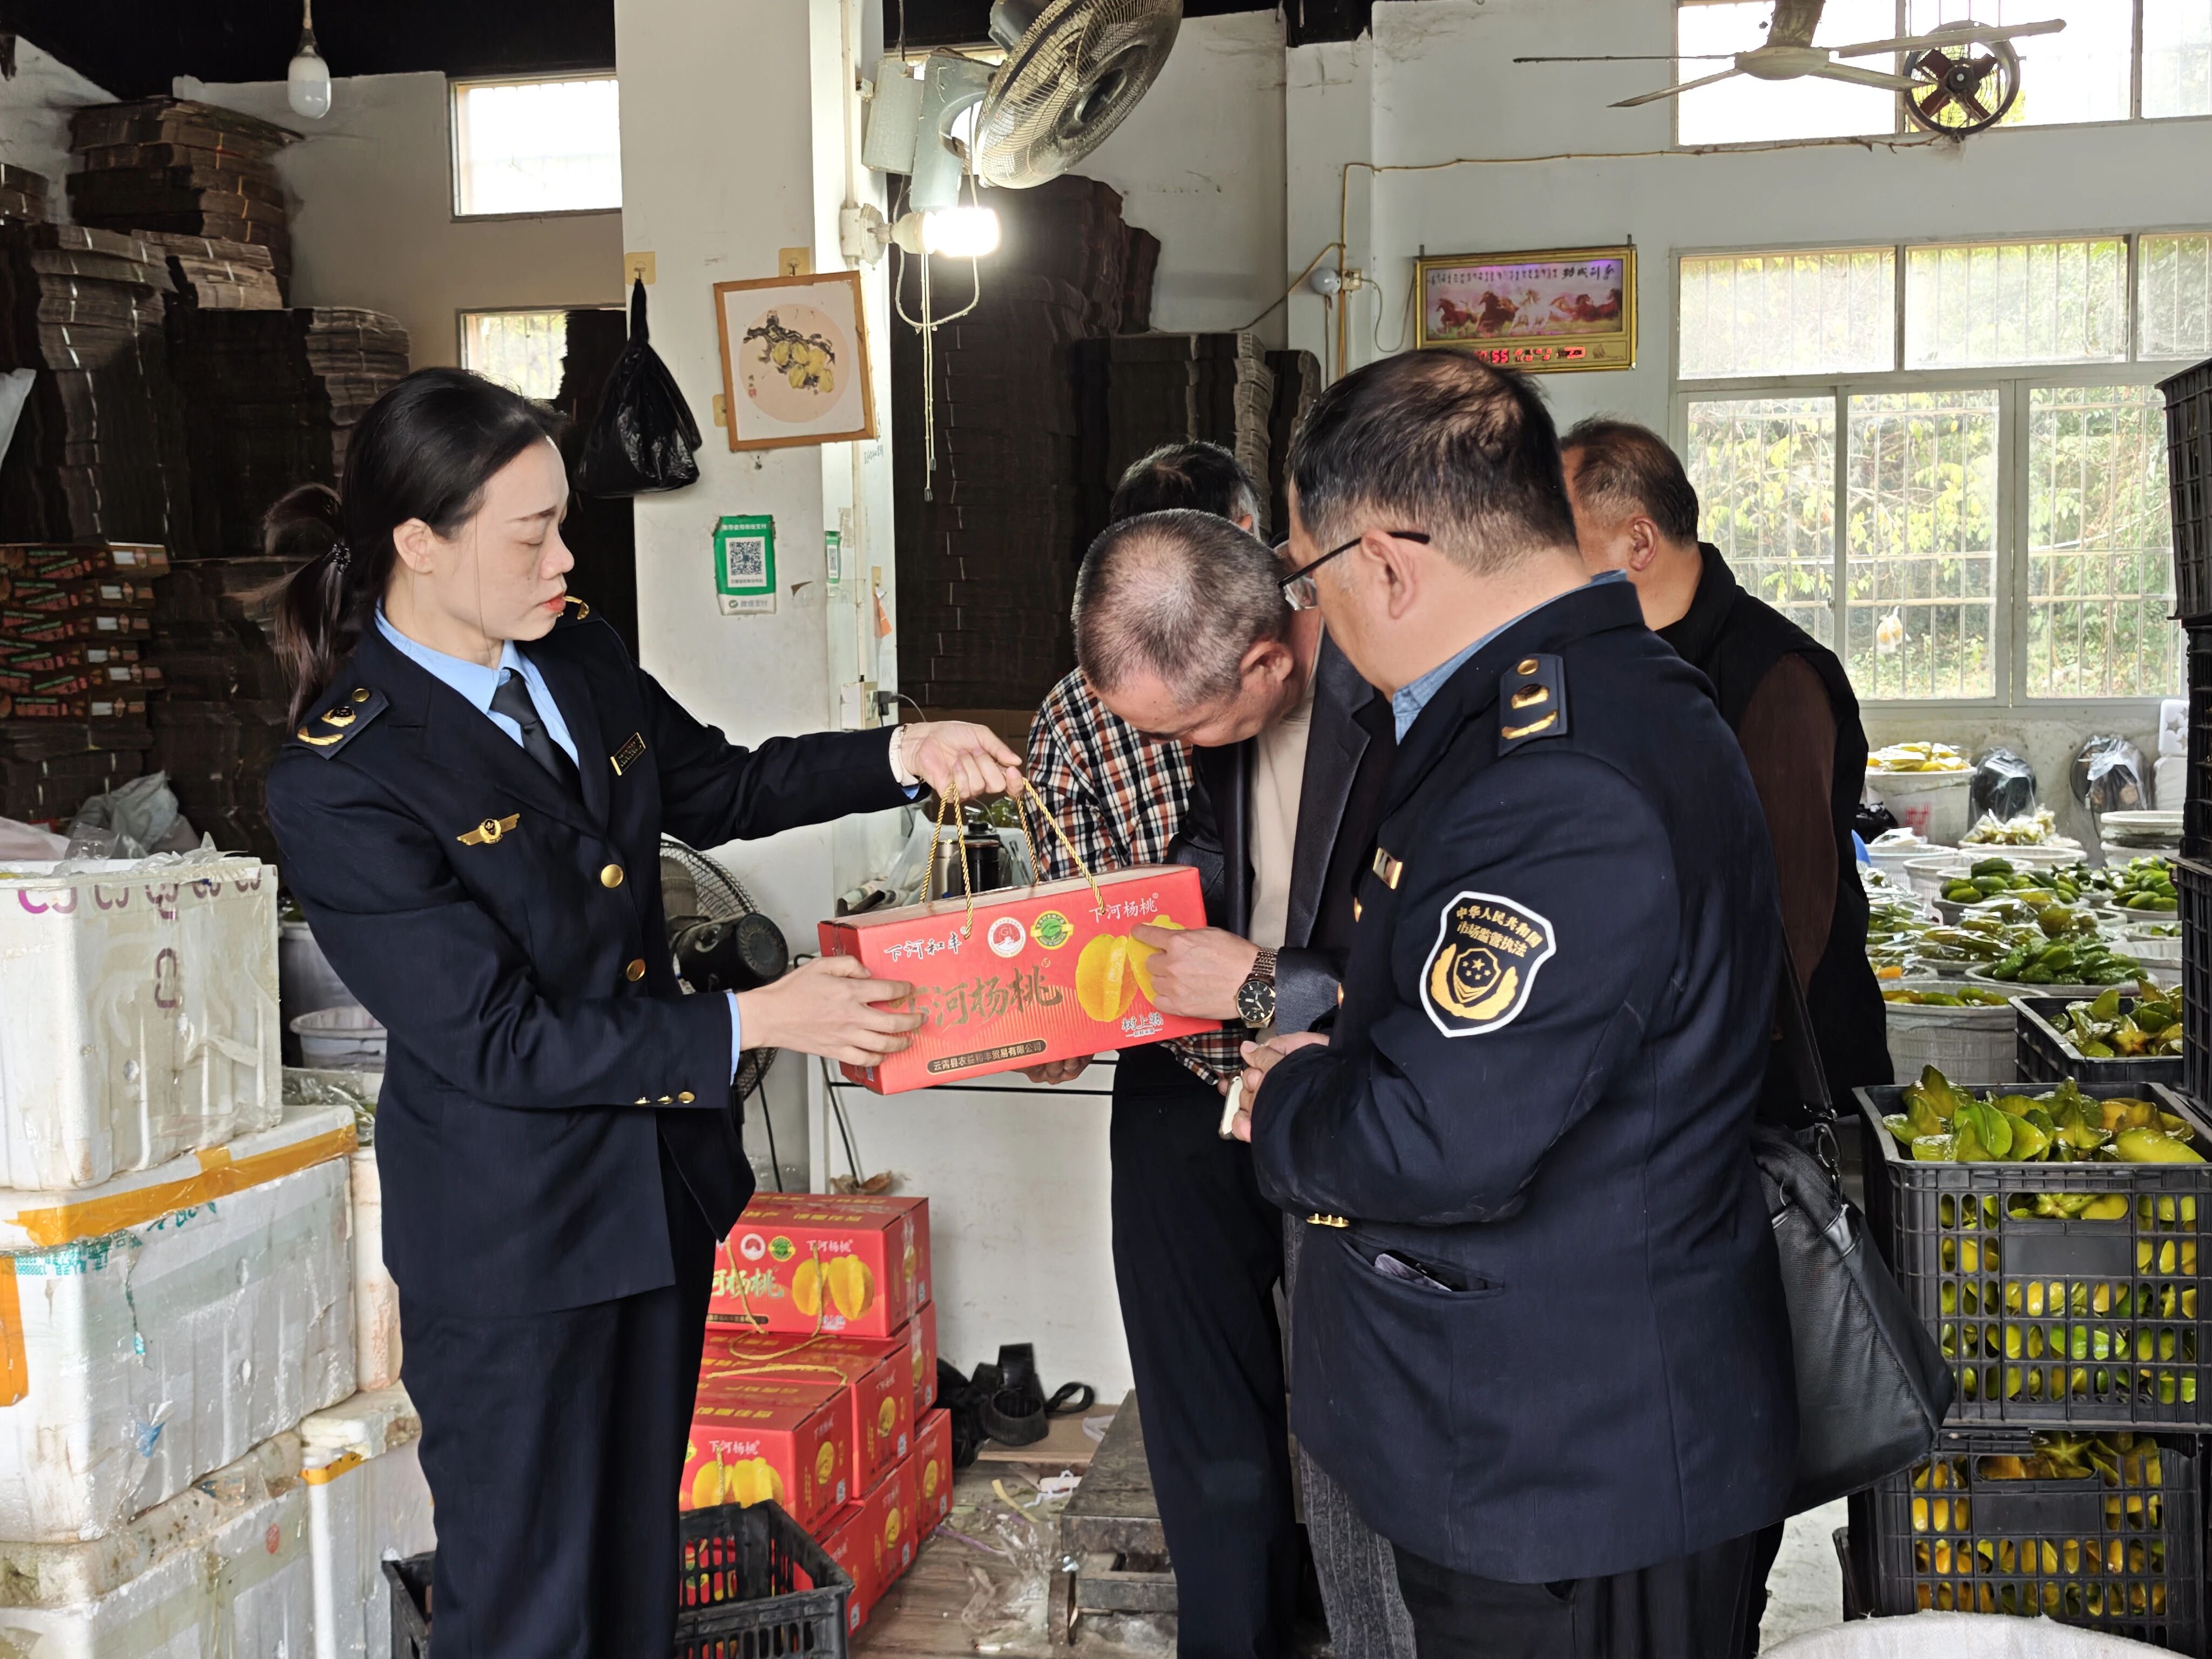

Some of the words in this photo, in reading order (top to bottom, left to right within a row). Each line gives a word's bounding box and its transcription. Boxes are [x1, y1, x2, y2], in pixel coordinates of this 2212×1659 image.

[1089, 898, 1158, 923] 下河杨桃
[1456, 905, 1543, 948] 中华人民共和国
[884, 931, 962, 963] 下河和丰
[1456, 921, 1528, 957] 市场监管执法
[933, 1041, 1042, 1071] 云霄县农益和丰贸易有限公司
